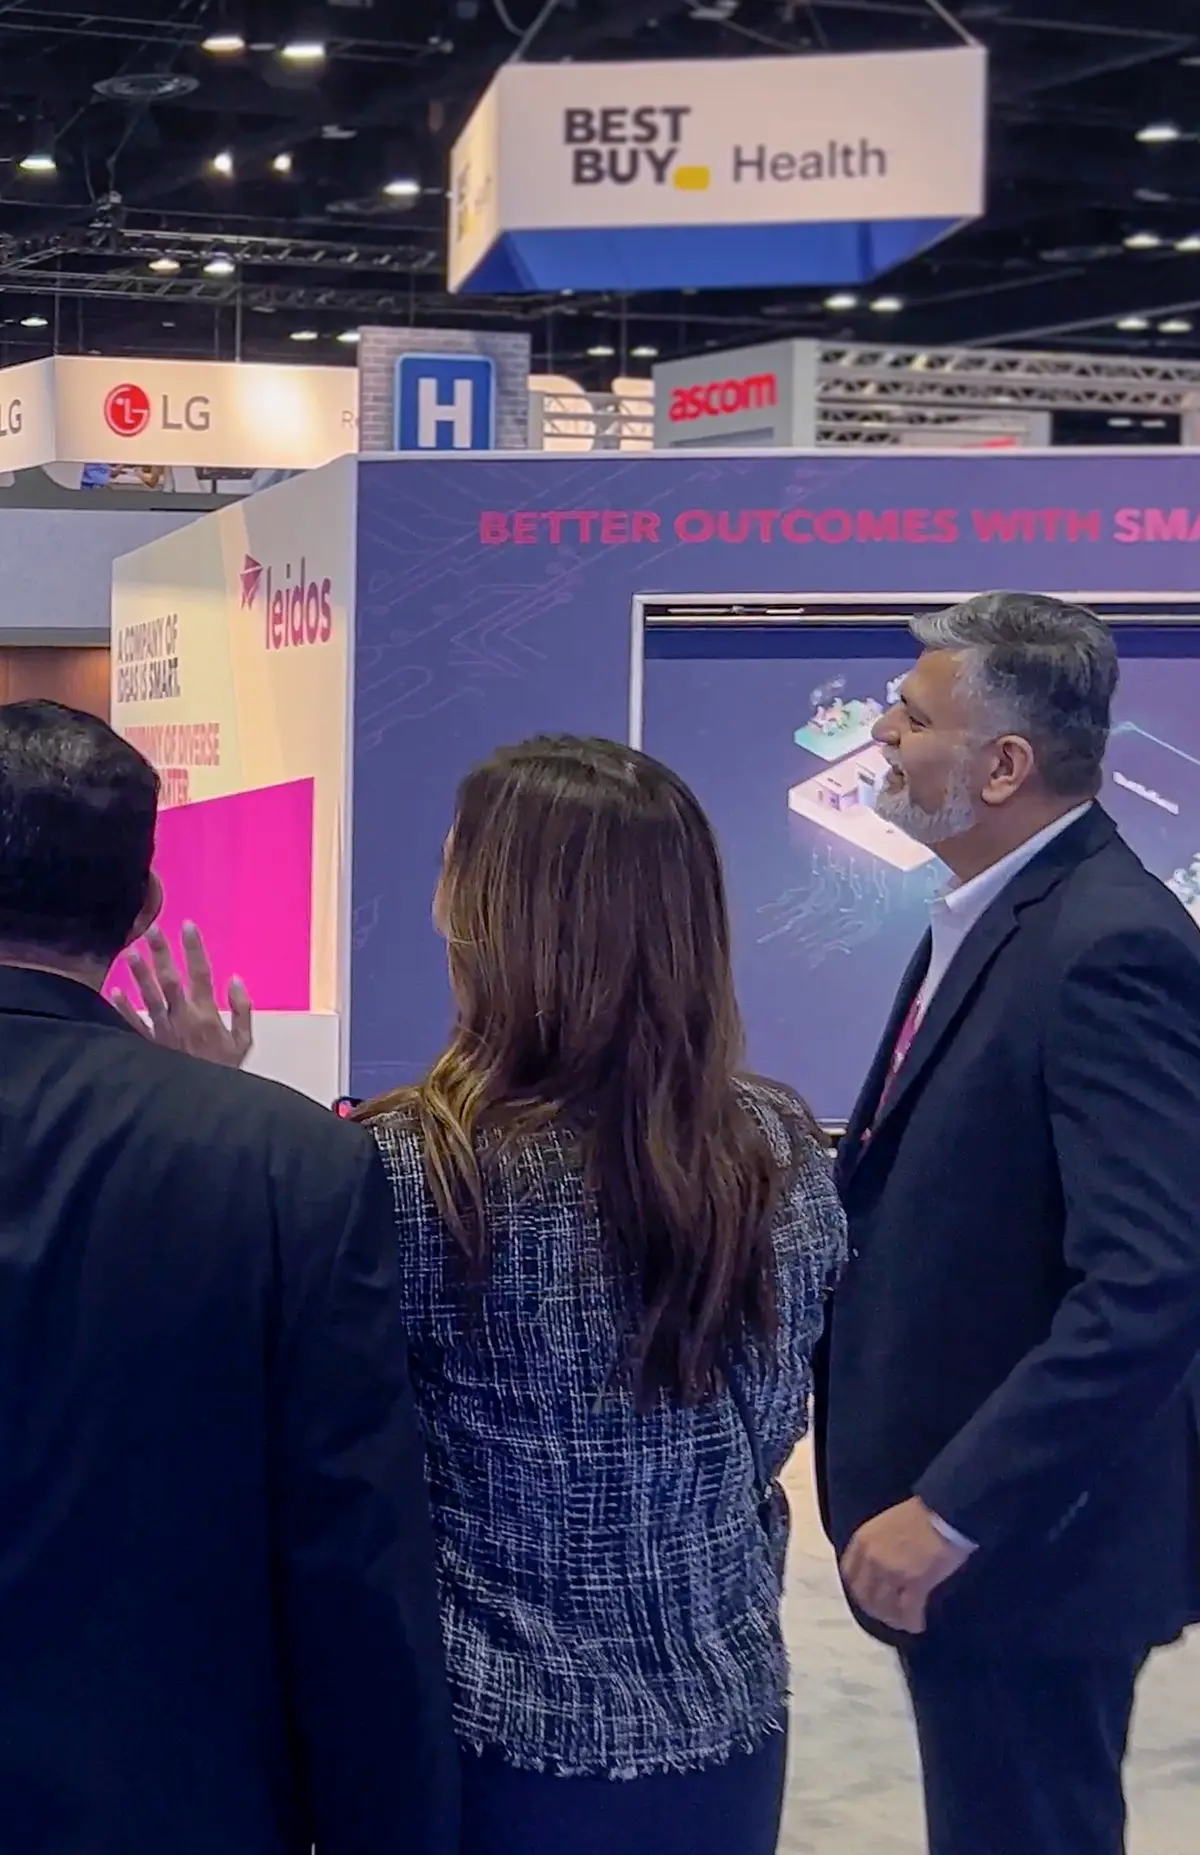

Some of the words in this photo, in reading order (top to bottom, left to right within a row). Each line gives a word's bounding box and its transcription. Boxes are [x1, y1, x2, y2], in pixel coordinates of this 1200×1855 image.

[563, 106, 691, 146] BEST
[572, 148, 678, 185] BUY
[732, 138, 887, 183] Health
[162, 394, 211, 431] LG
[416, 378, 472, 448] H
[668, 372, 778, 423] ascom
[341, 410, 359, 430] R
[479, 509, 662, 545] BETTER
[673, 508, 959, 545] OUTCOMES
[971, 508, 1101, 544] WITH
[265, 556, 333, 651] leidos
